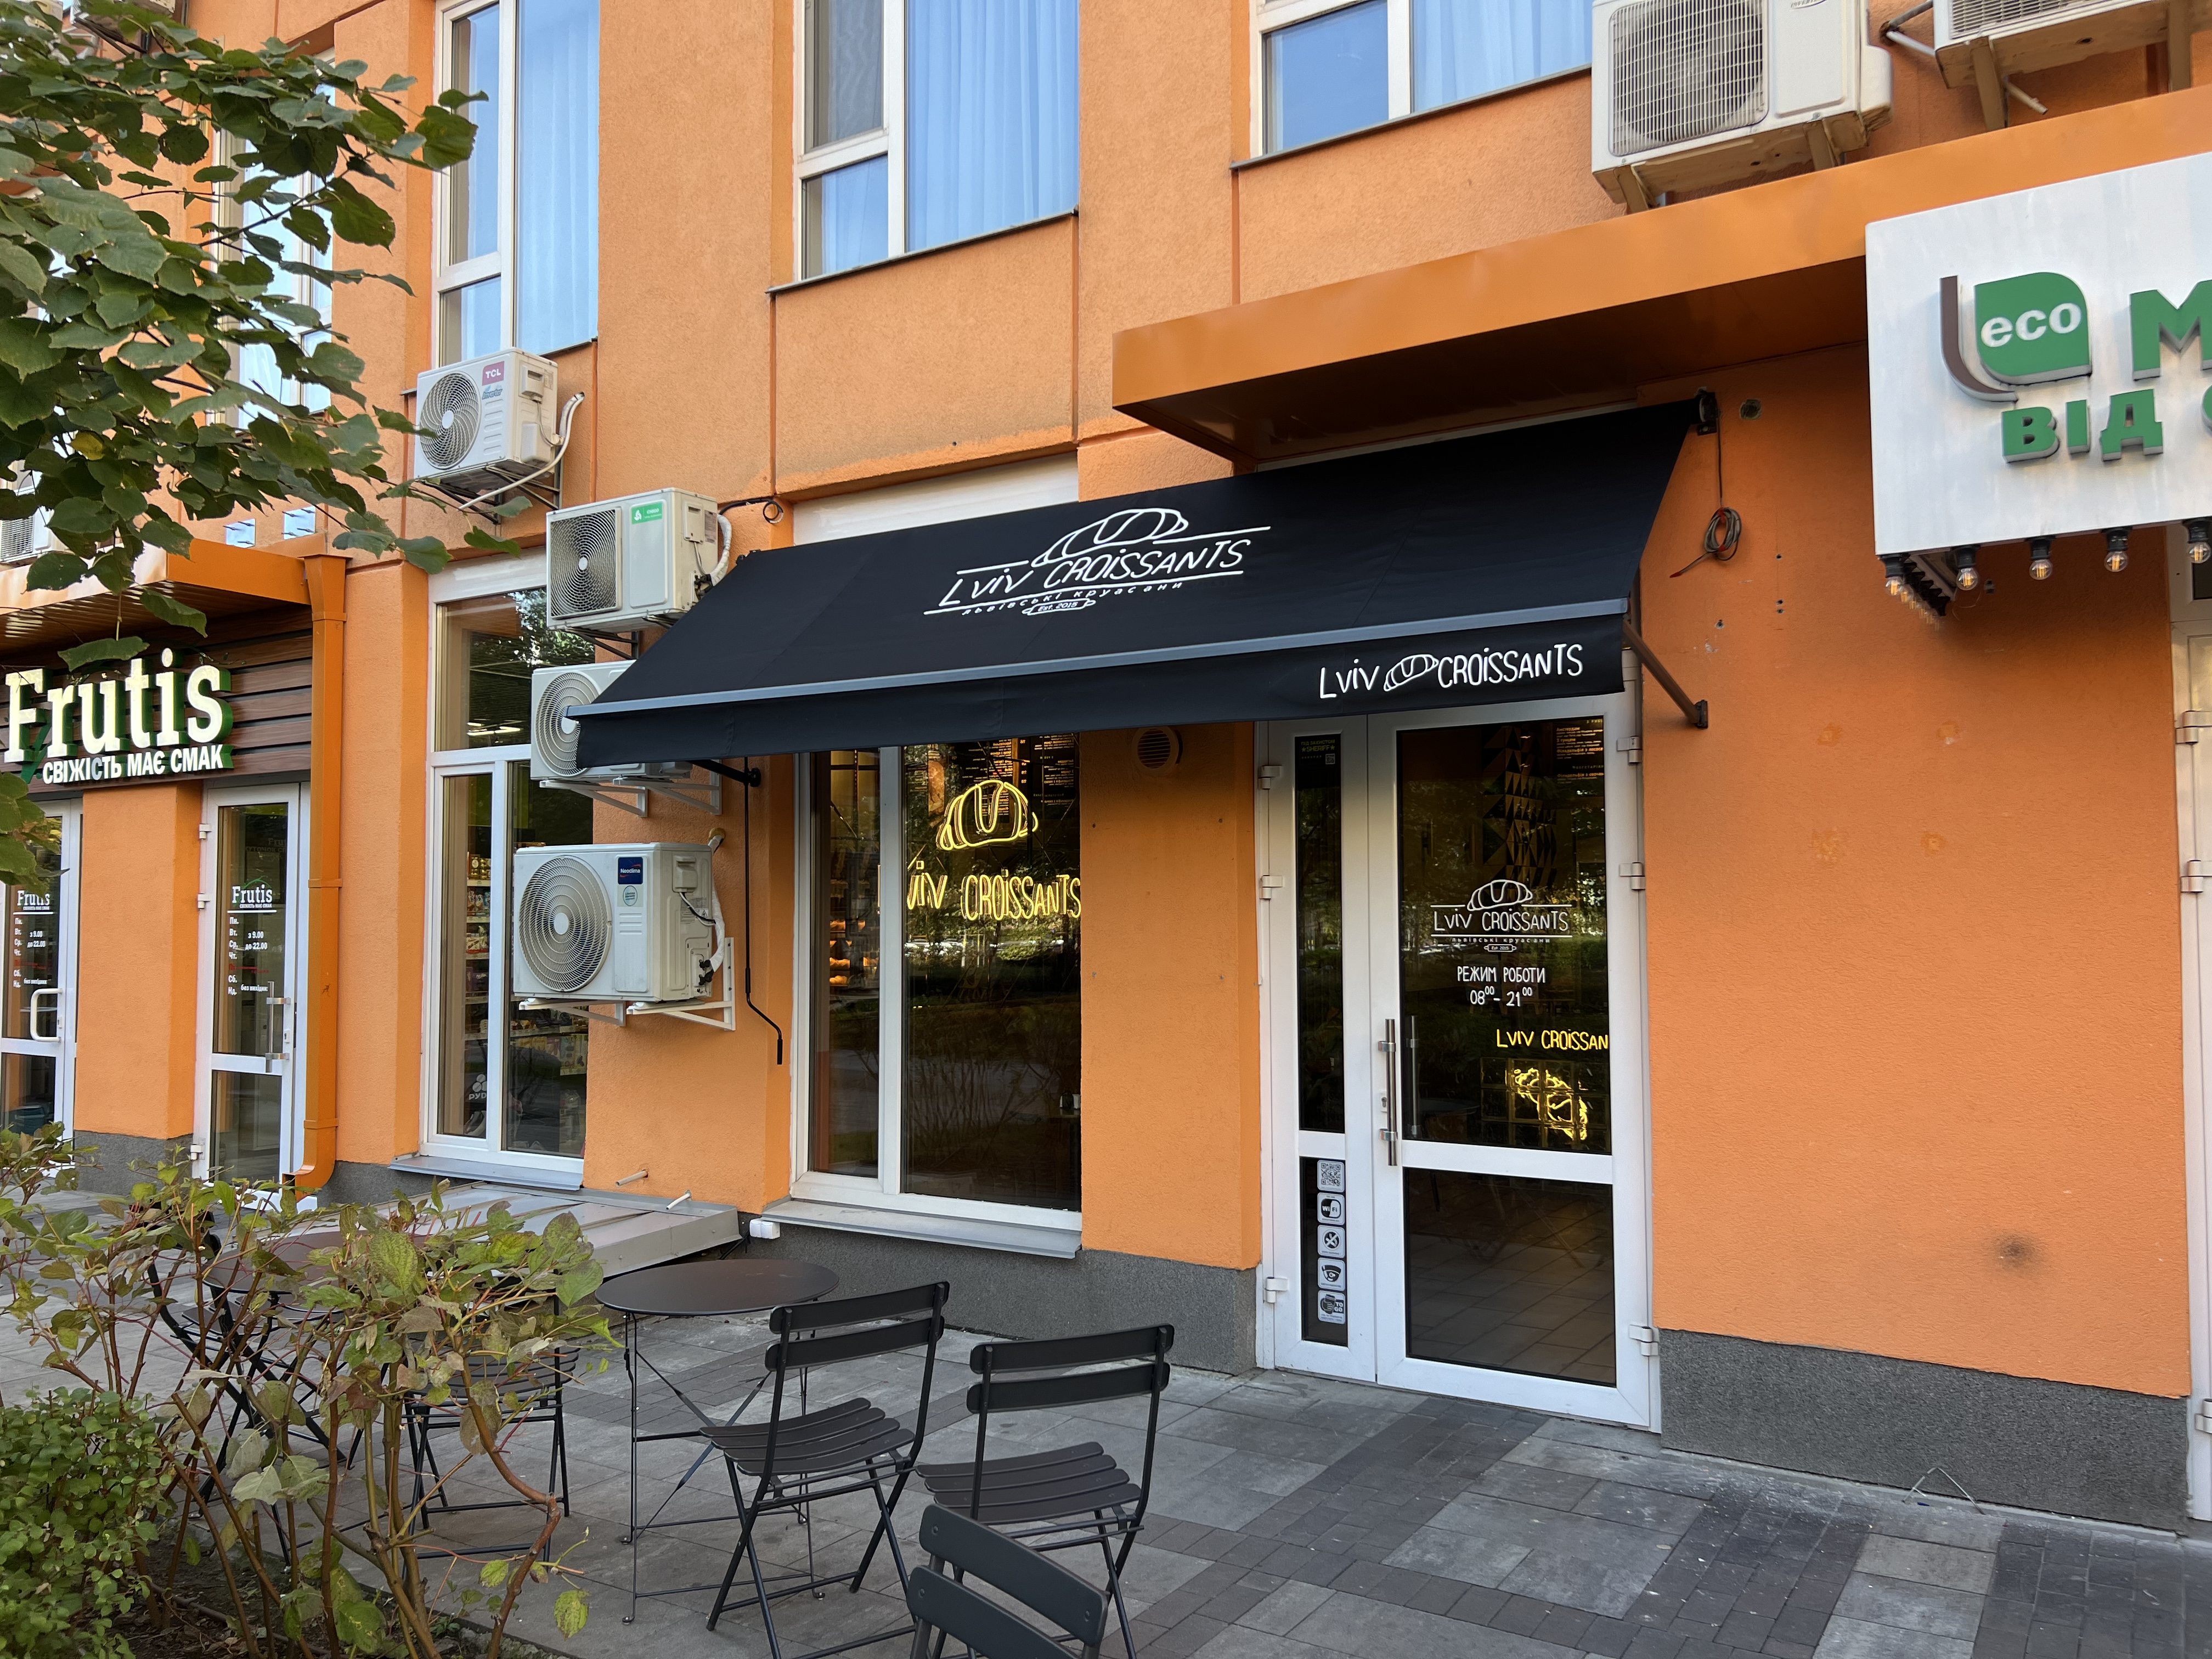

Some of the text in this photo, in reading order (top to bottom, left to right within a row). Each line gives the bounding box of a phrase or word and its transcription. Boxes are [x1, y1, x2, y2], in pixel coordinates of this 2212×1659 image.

[1981, 302, 2081, 347] eco
[486, 369, 501, 379] TCL
[2001, 389, 2163, 463] ВІД
[3, 647, 229, 763] Frutis
[43, 745, 224, 785] СВІЖІСТЬ МАЄ СМАК
[232, 884, 273, 904] Frutis
[229, 940, 238, 949] Ср.
[1457, 966, 1546, 983] РЕЖИМ РОБОТИ
